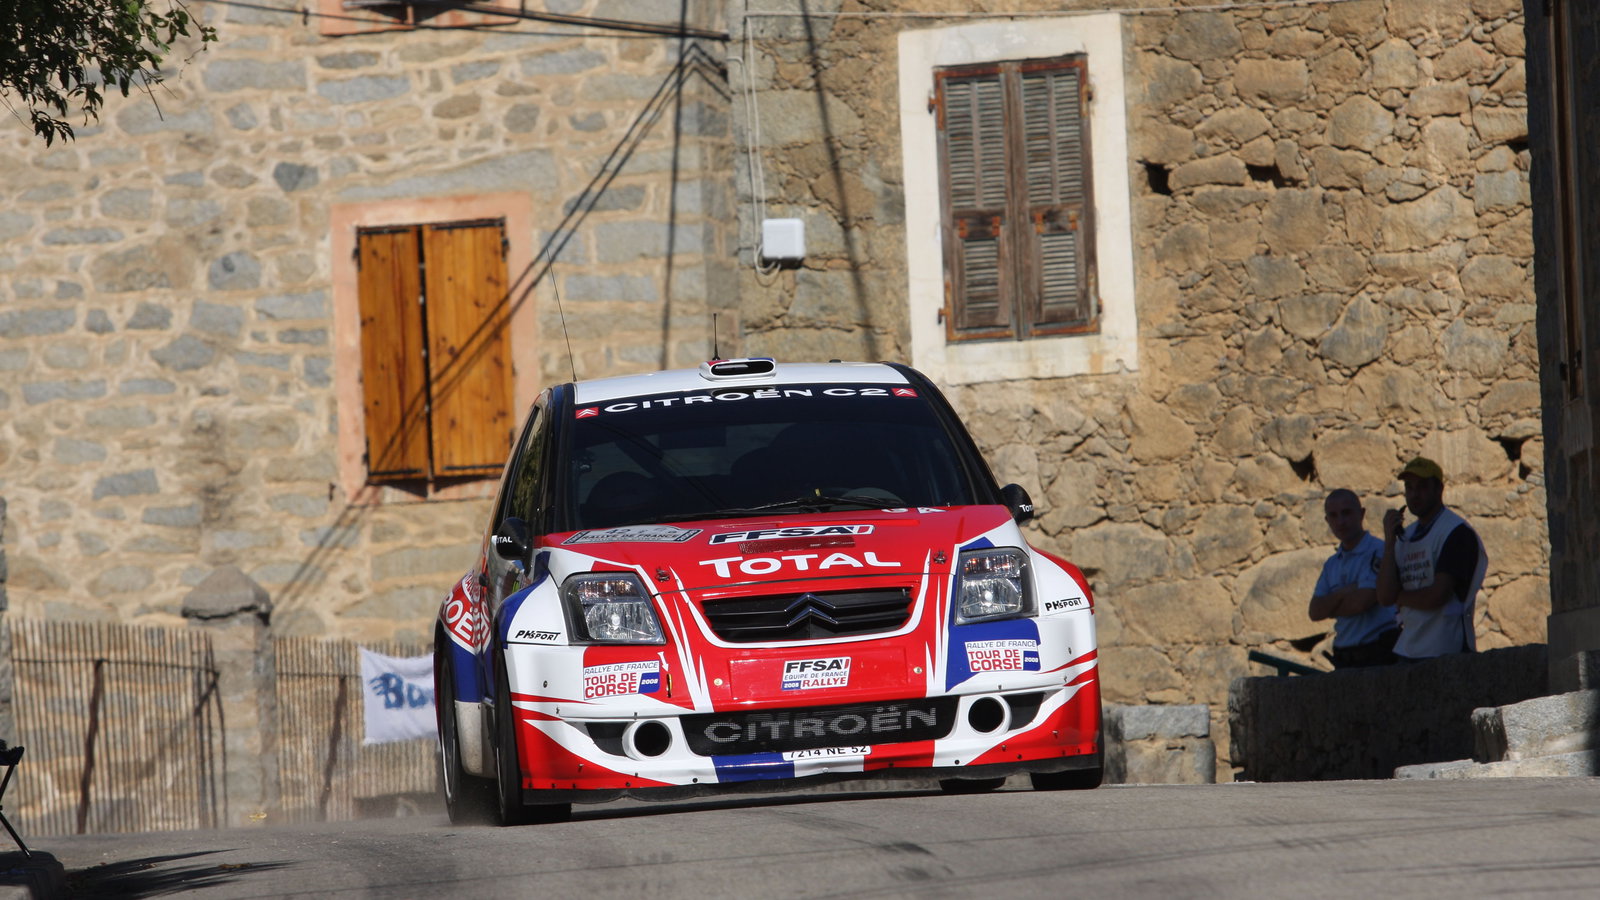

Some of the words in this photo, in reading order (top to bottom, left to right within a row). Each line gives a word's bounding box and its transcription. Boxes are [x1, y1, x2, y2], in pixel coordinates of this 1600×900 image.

[604, 388, 813, 413] CITROËN
[822, 387, 889, 397] C2
[711, 526, 850, 544] FFSA
[699, 551, 901, 578] TOTAL
[968, 649, 1001, 659] TOUR
[1004, 649, 1020, 658] DE
[584, 665, 612, 675] RALLYE
[626, 662, 658, 670] FRANCE
[786, 659, 842, 673] FFSA
[970, 658, 1022, 671] CORSE
[585, 674, 616, 686] TOUR
[621, 672, 636, 682] DE
[802, 677, 847, 687] RALLYE
[585, 682, 637, 698] CORSE
[703, 705, 937, 743] CITROËN
[826, 747, 846, 755] NE
